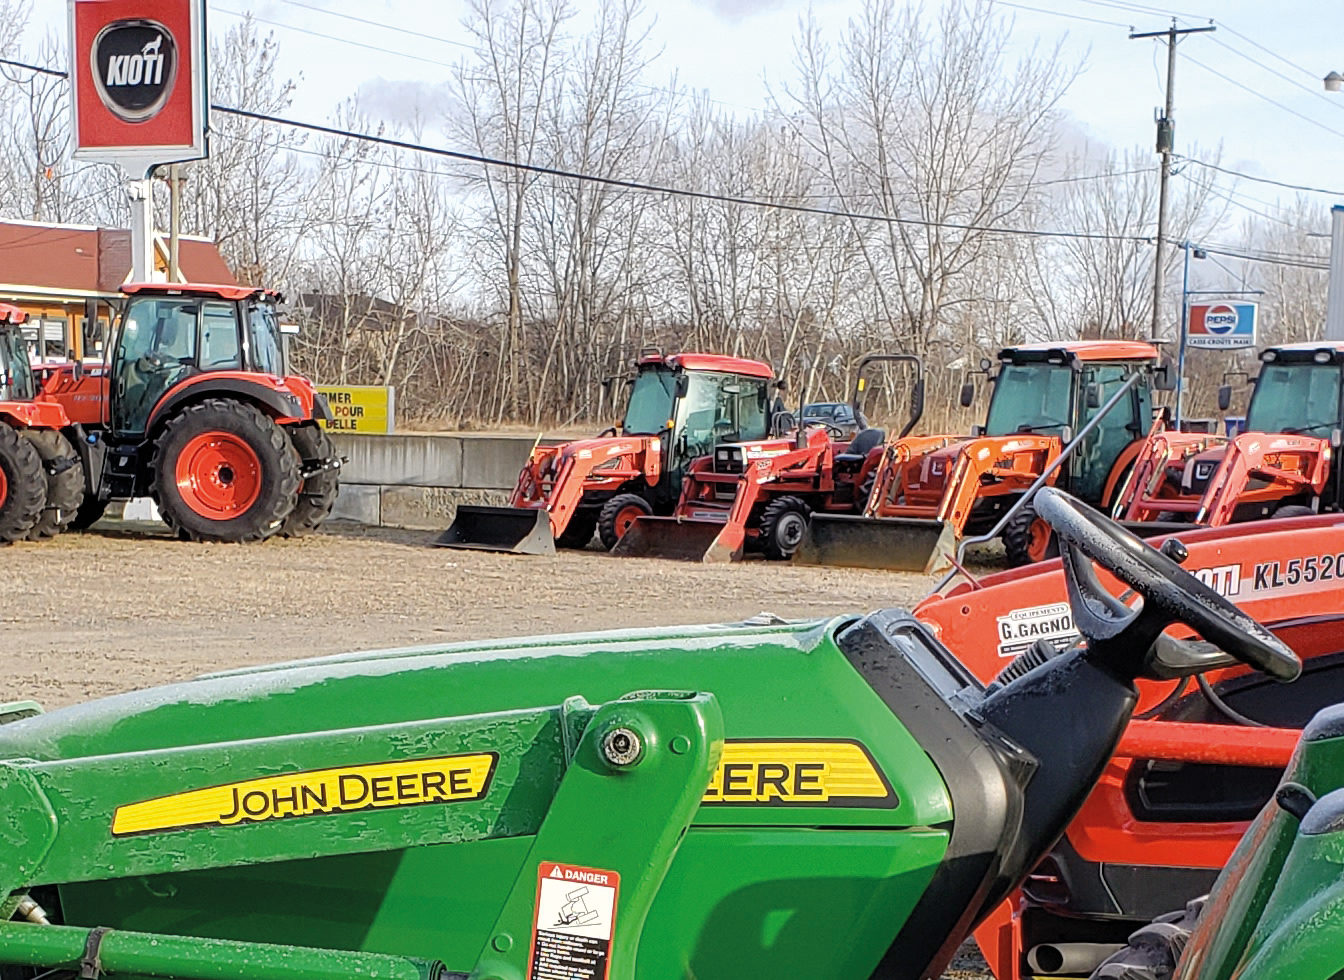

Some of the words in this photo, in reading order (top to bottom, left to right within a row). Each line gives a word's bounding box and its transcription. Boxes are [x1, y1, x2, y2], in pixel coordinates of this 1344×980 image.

[106, 53, 164, 86] KIOTI
[1206, 315, 1236, 324] PEPSI
[335, 406, 364, 417] POUR
[219, 783, 328, 820] JOHN
[338, 768, 473, 807] DEERE
[564, 869, 609, 885] DANGER
